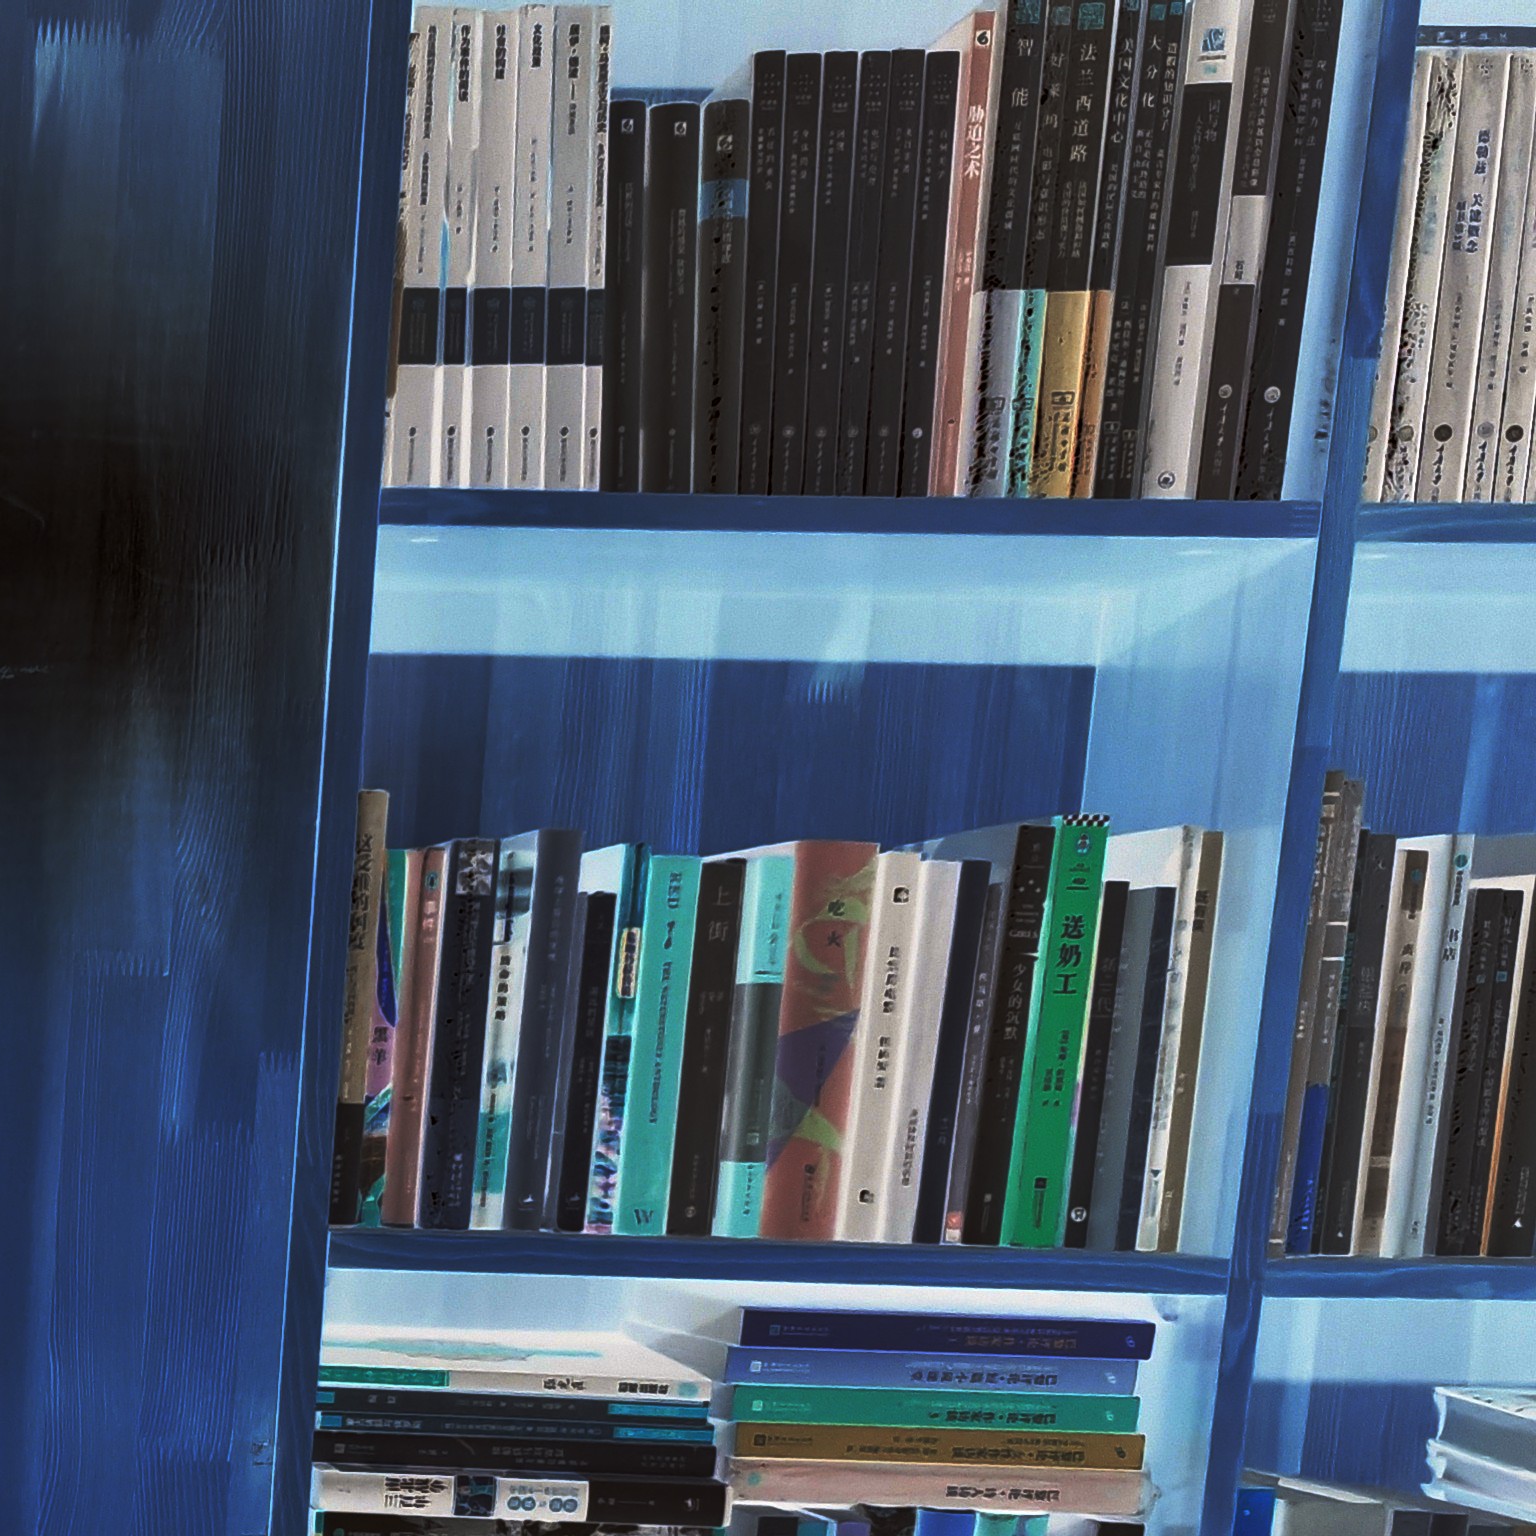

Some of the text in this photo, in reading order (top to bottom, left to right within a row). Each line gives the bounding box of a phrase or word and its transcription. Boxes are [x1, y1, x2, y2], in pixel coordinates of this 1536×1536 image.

[1011, 36, 1034, 109] 智能
[1068, 42, 1098, 163] 法兰西道路
[1143, 34, 1160, 109] 大分化
[1052, 914, 1086, 995] 送奶工
[1003, 962, 1028, 1041] 少女的沉默
